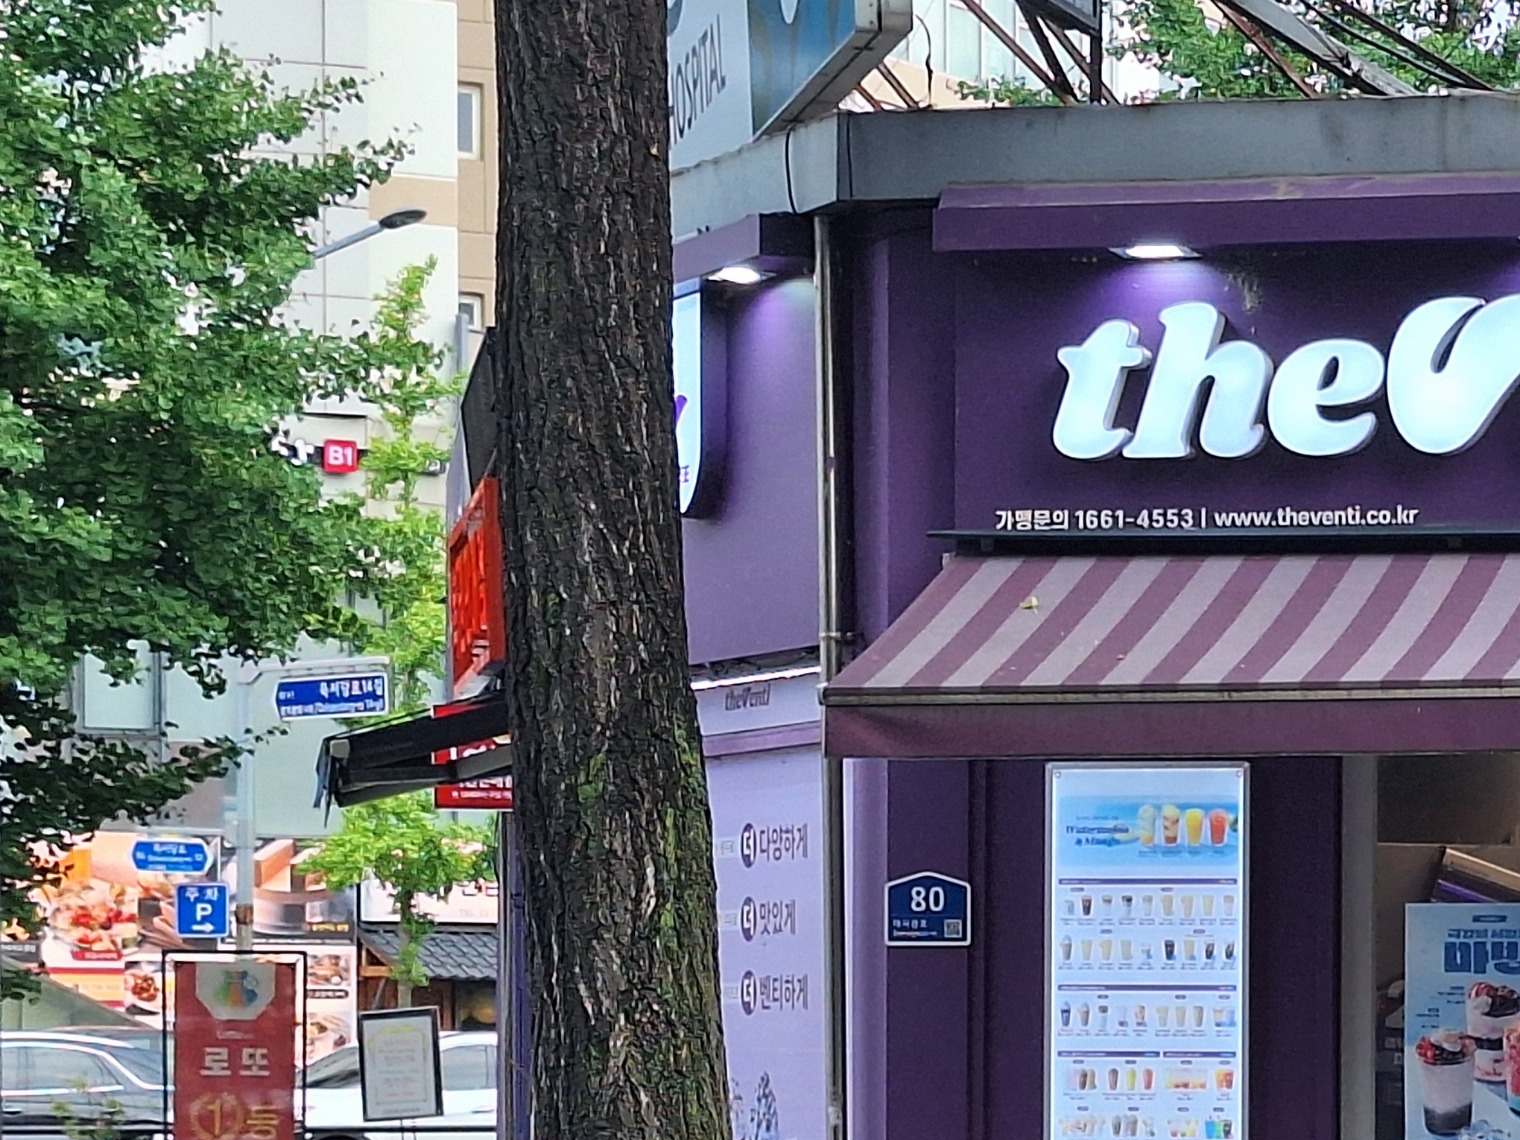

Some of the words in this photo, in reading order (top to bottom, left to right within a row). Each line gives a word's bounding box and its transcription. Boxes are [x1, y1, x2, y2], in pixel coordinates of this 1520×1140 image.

[668, 13, 727, 144] HOSPITAL
[327, 446, 354, 466] B1
[995, 510, 1069, 531] 가맹문의
[1074, 508, 1195, 529] 1661-4553
[1214, 505, 1419, 528] www.theventi.co.kr
[759, 823, 808, 861] 다양하게
[196, 903, 212, 921] P
[910, 886, 945, 912] 80
[759, 899, 797, 936] 맛있게
[200, 1047, 271, 1077] 로또
